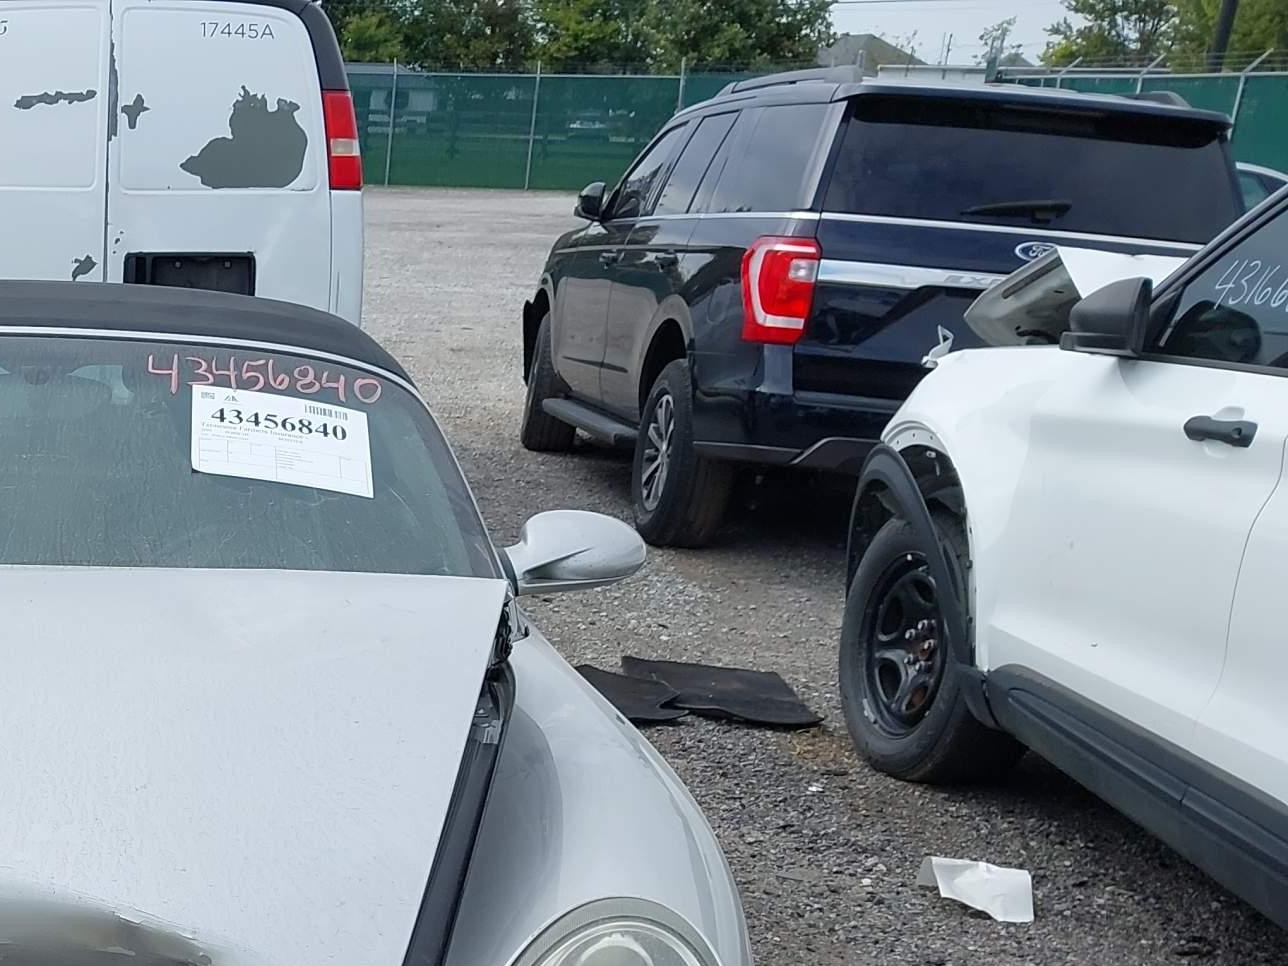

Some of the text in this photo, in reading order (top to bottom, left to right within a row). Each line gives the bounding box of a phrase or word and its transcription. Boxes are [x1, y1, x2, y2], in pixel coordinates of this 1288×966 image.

[199, 22, 275, 40] 17445A
[1213, 259, 1288, 313] 43166
[148, 353, 382, 404] 43456840
[211, 407, 348, 441] 43456840
